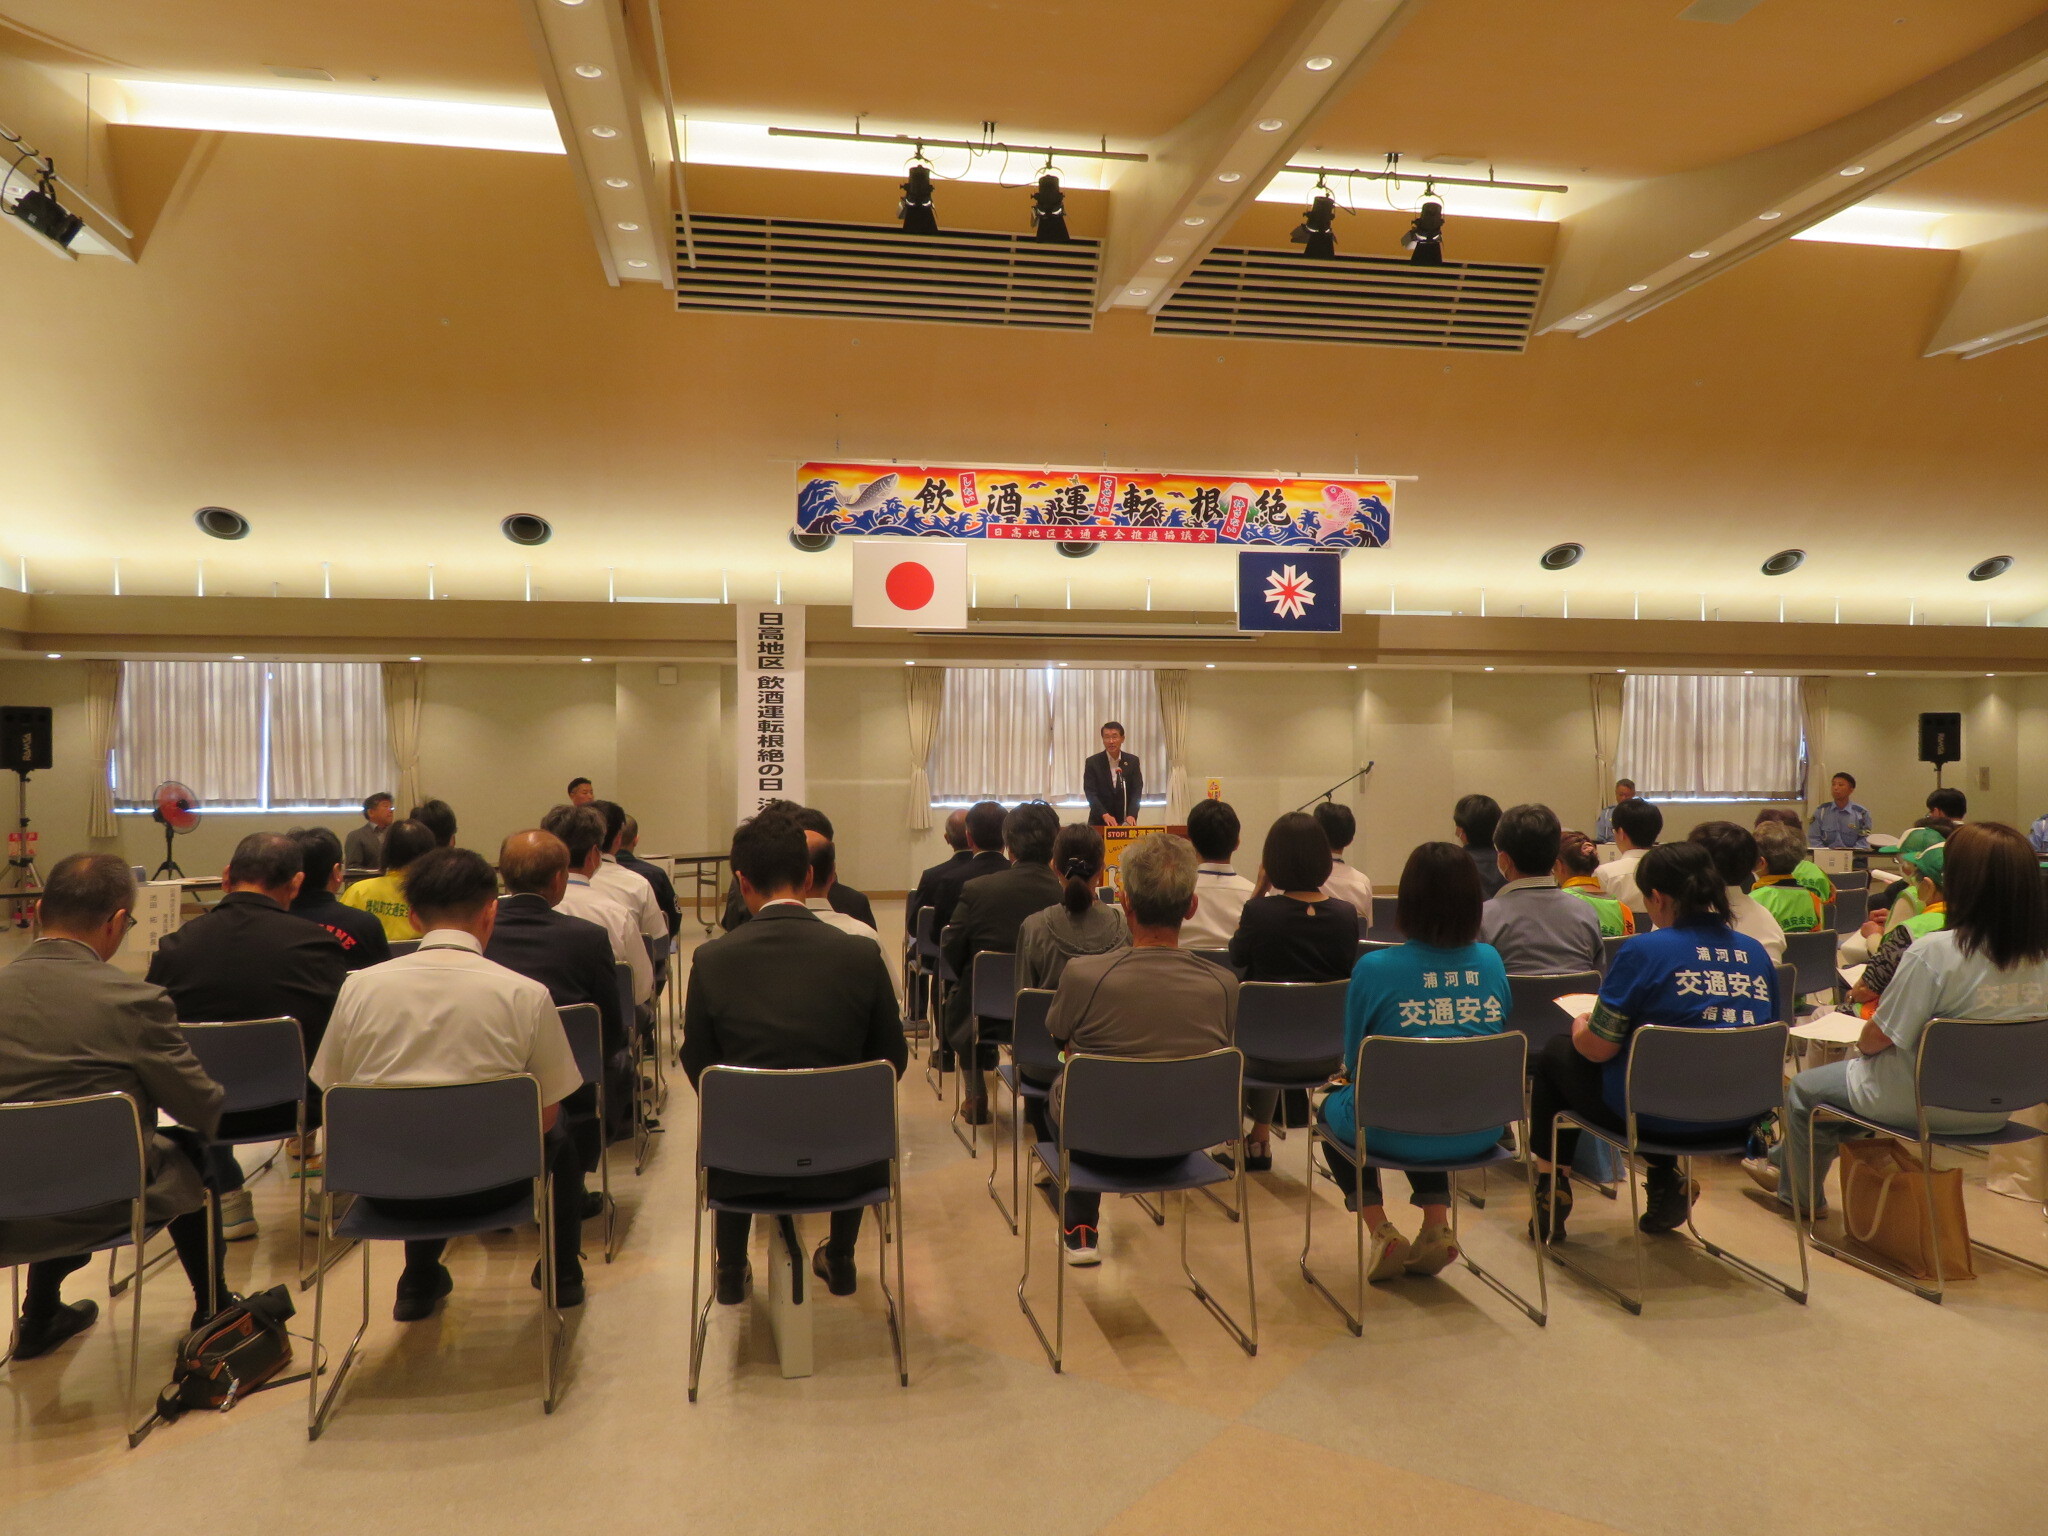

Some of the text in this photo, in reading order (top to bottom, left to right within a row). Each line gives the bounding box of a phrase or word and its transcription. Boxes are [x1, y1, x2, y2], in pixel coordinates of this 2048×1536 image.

[914, 478, 1292, 526] 飲酒運転根絶
[962, 477, 975, 503] しない
[1098, 478, 1113, 513] させない
[994, 528, 1210, 542] 日高地区交通安全推進協議会
[757, 612, 785, 670] 日高地区
[757, 676, 785, 791] 飲酒運転根絶の日
[1696, 947, 1749, 964] 浦河町
[1423, 971, 1480, 988] 浦河町
[1675, 969, 1771, 1002] 交通安全
[1399, 995, 1501, 1027] 交通安全
[1702, 1006, 1756, 1026] 指導員
